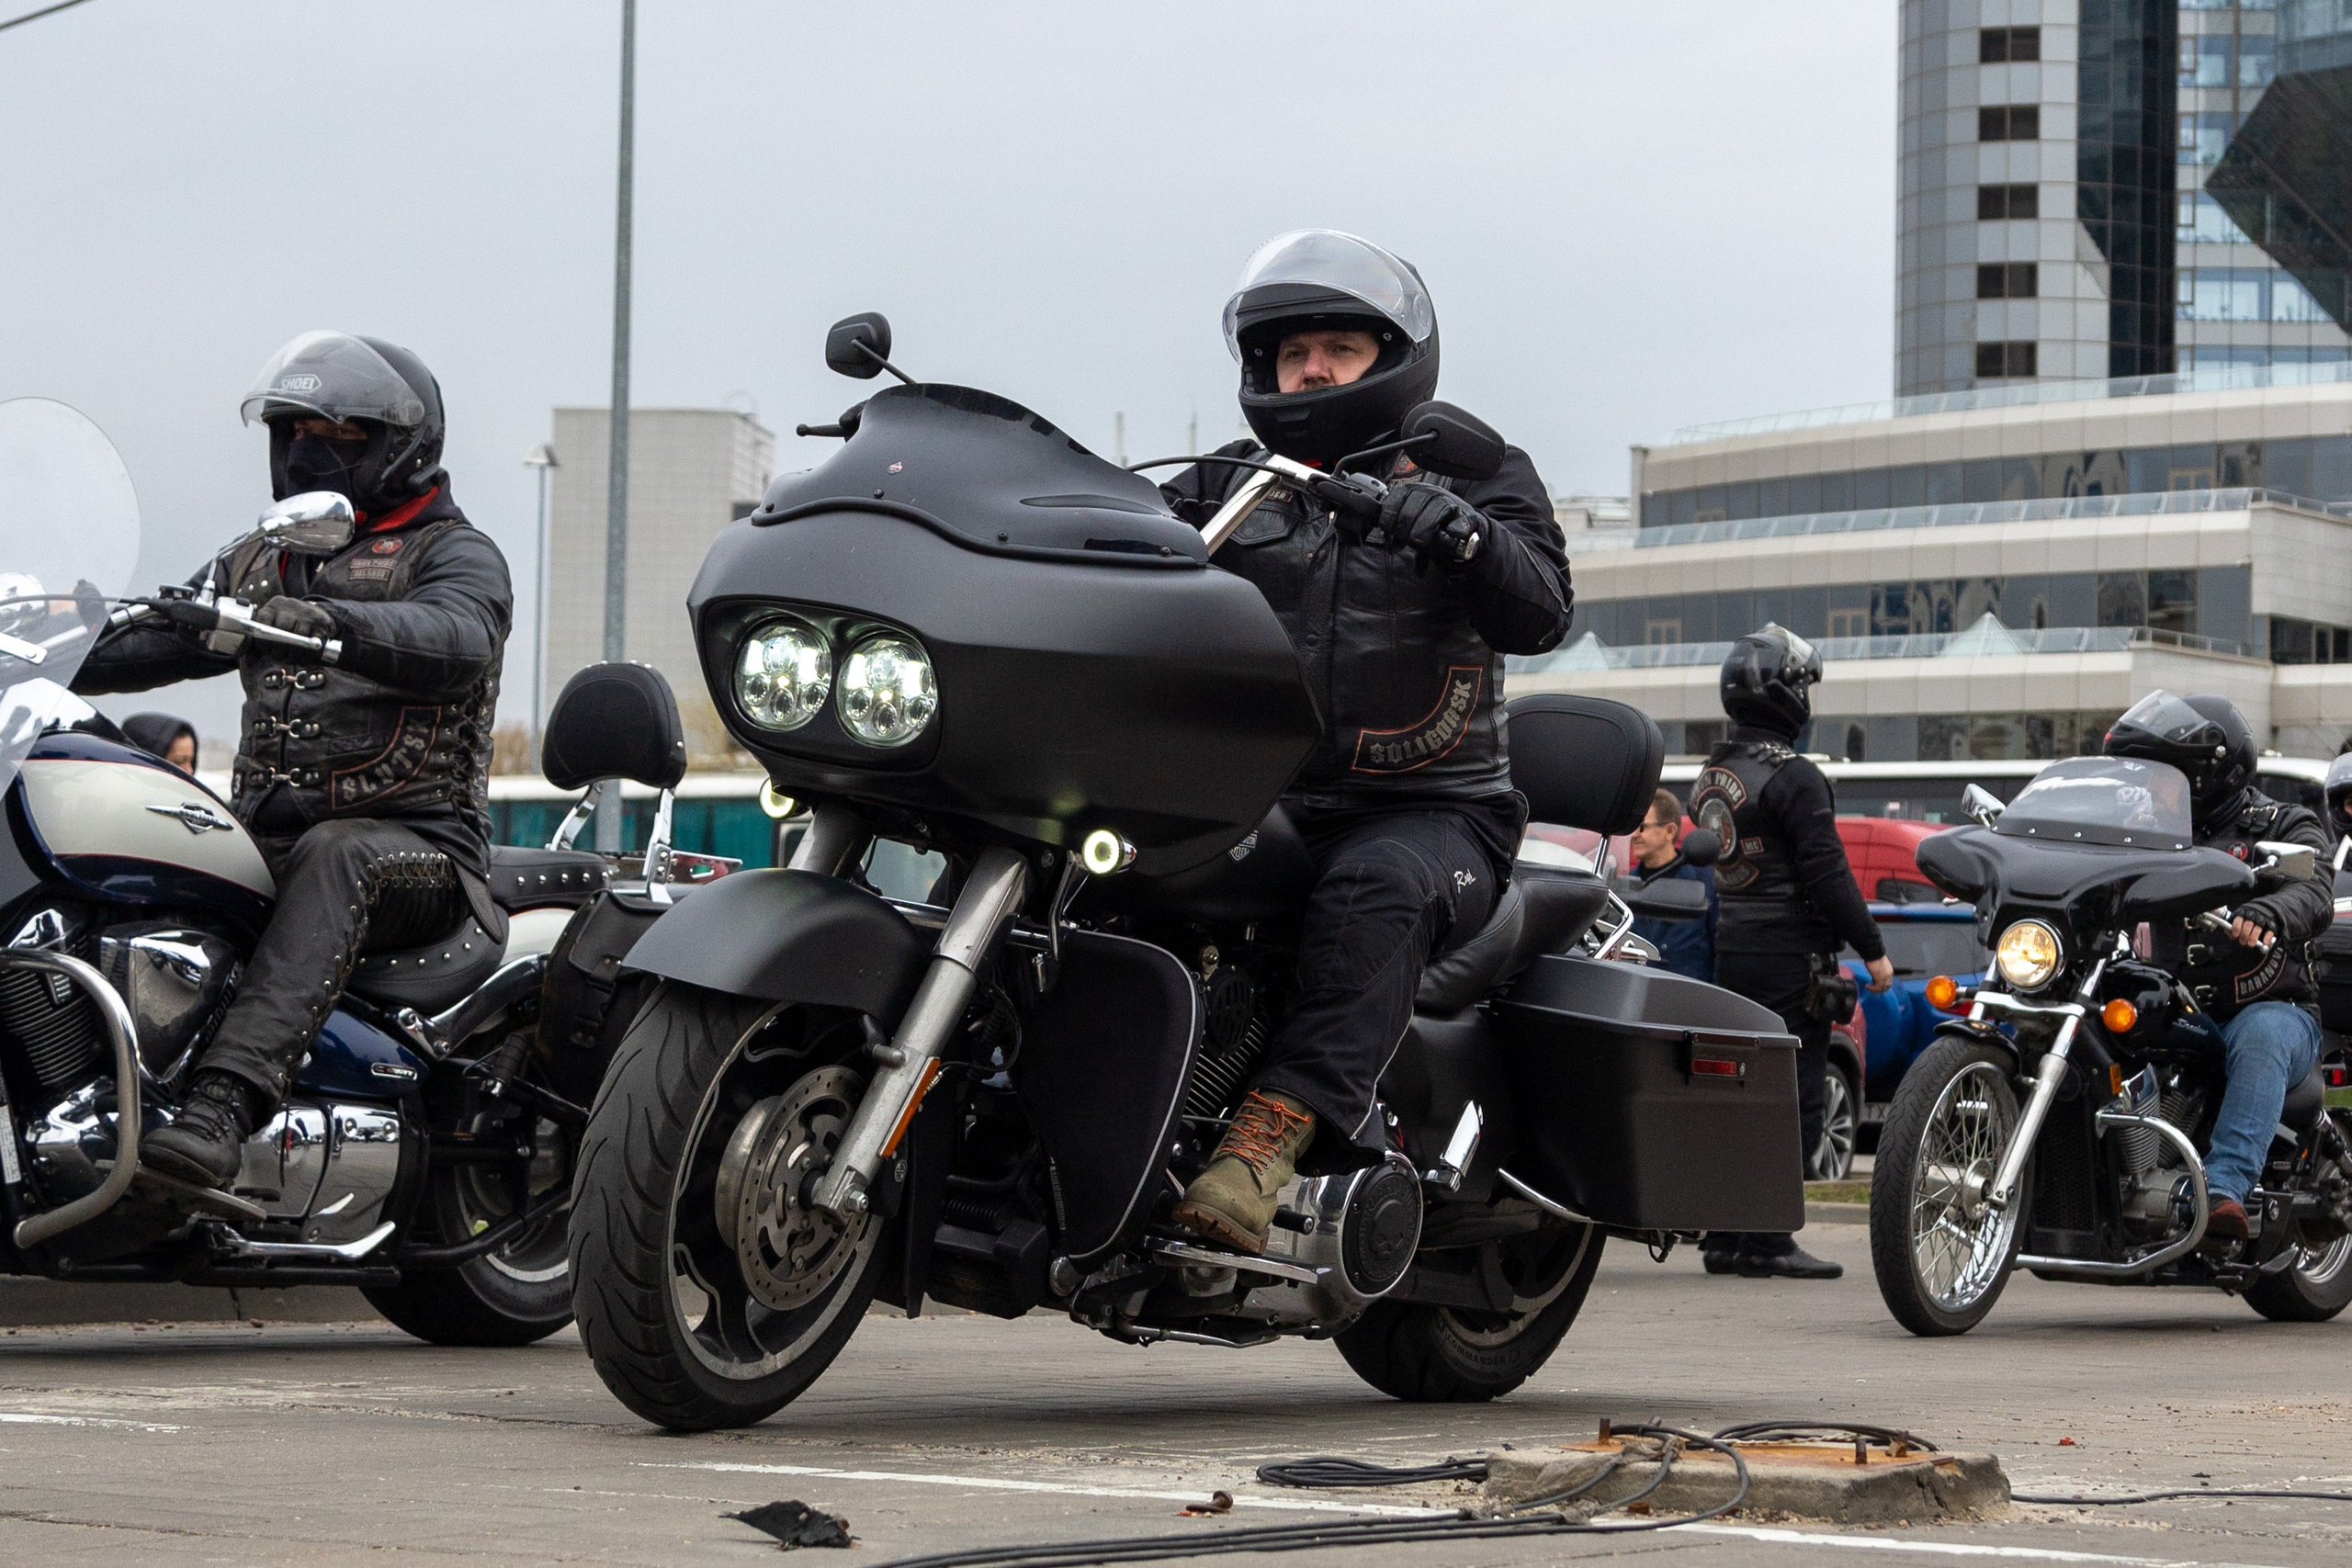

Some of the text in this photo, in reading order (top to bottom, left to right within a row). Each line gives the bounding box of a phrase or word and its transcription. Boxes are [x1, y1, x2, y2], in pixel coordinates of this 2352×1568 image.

[283, 376, 315, 391] SHOEI
[1714, 772, 1742, 802] PRIDE
[1745, 840, 1759, 851] MC
